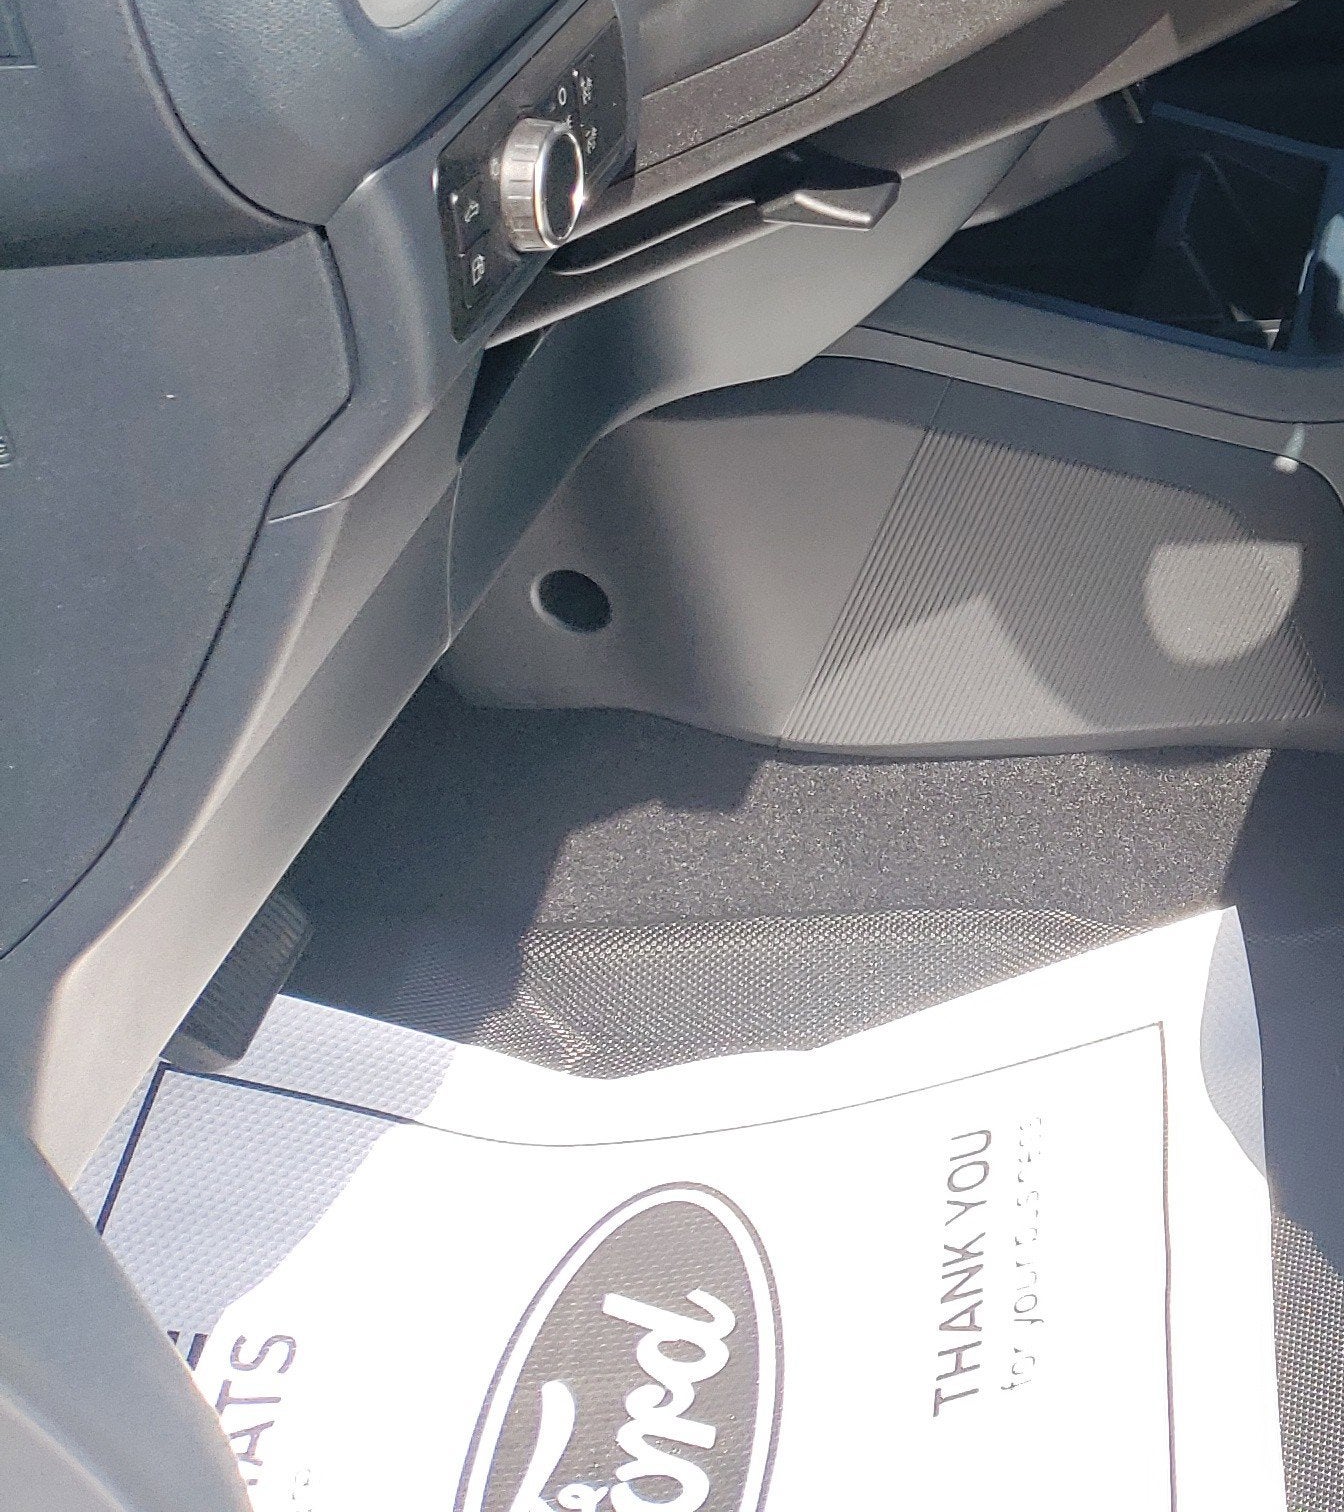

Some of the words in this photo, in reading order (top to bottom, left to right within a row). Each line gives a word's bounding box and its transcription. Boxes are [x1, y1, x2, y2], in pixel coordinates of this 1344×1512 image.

[945, 1128, 993, 1226] YOU
[933, 1231, 987, 1418] THANK
[1000, 1347, 1036, 1391] for
[214, 1333, 298, 1486] ATS
